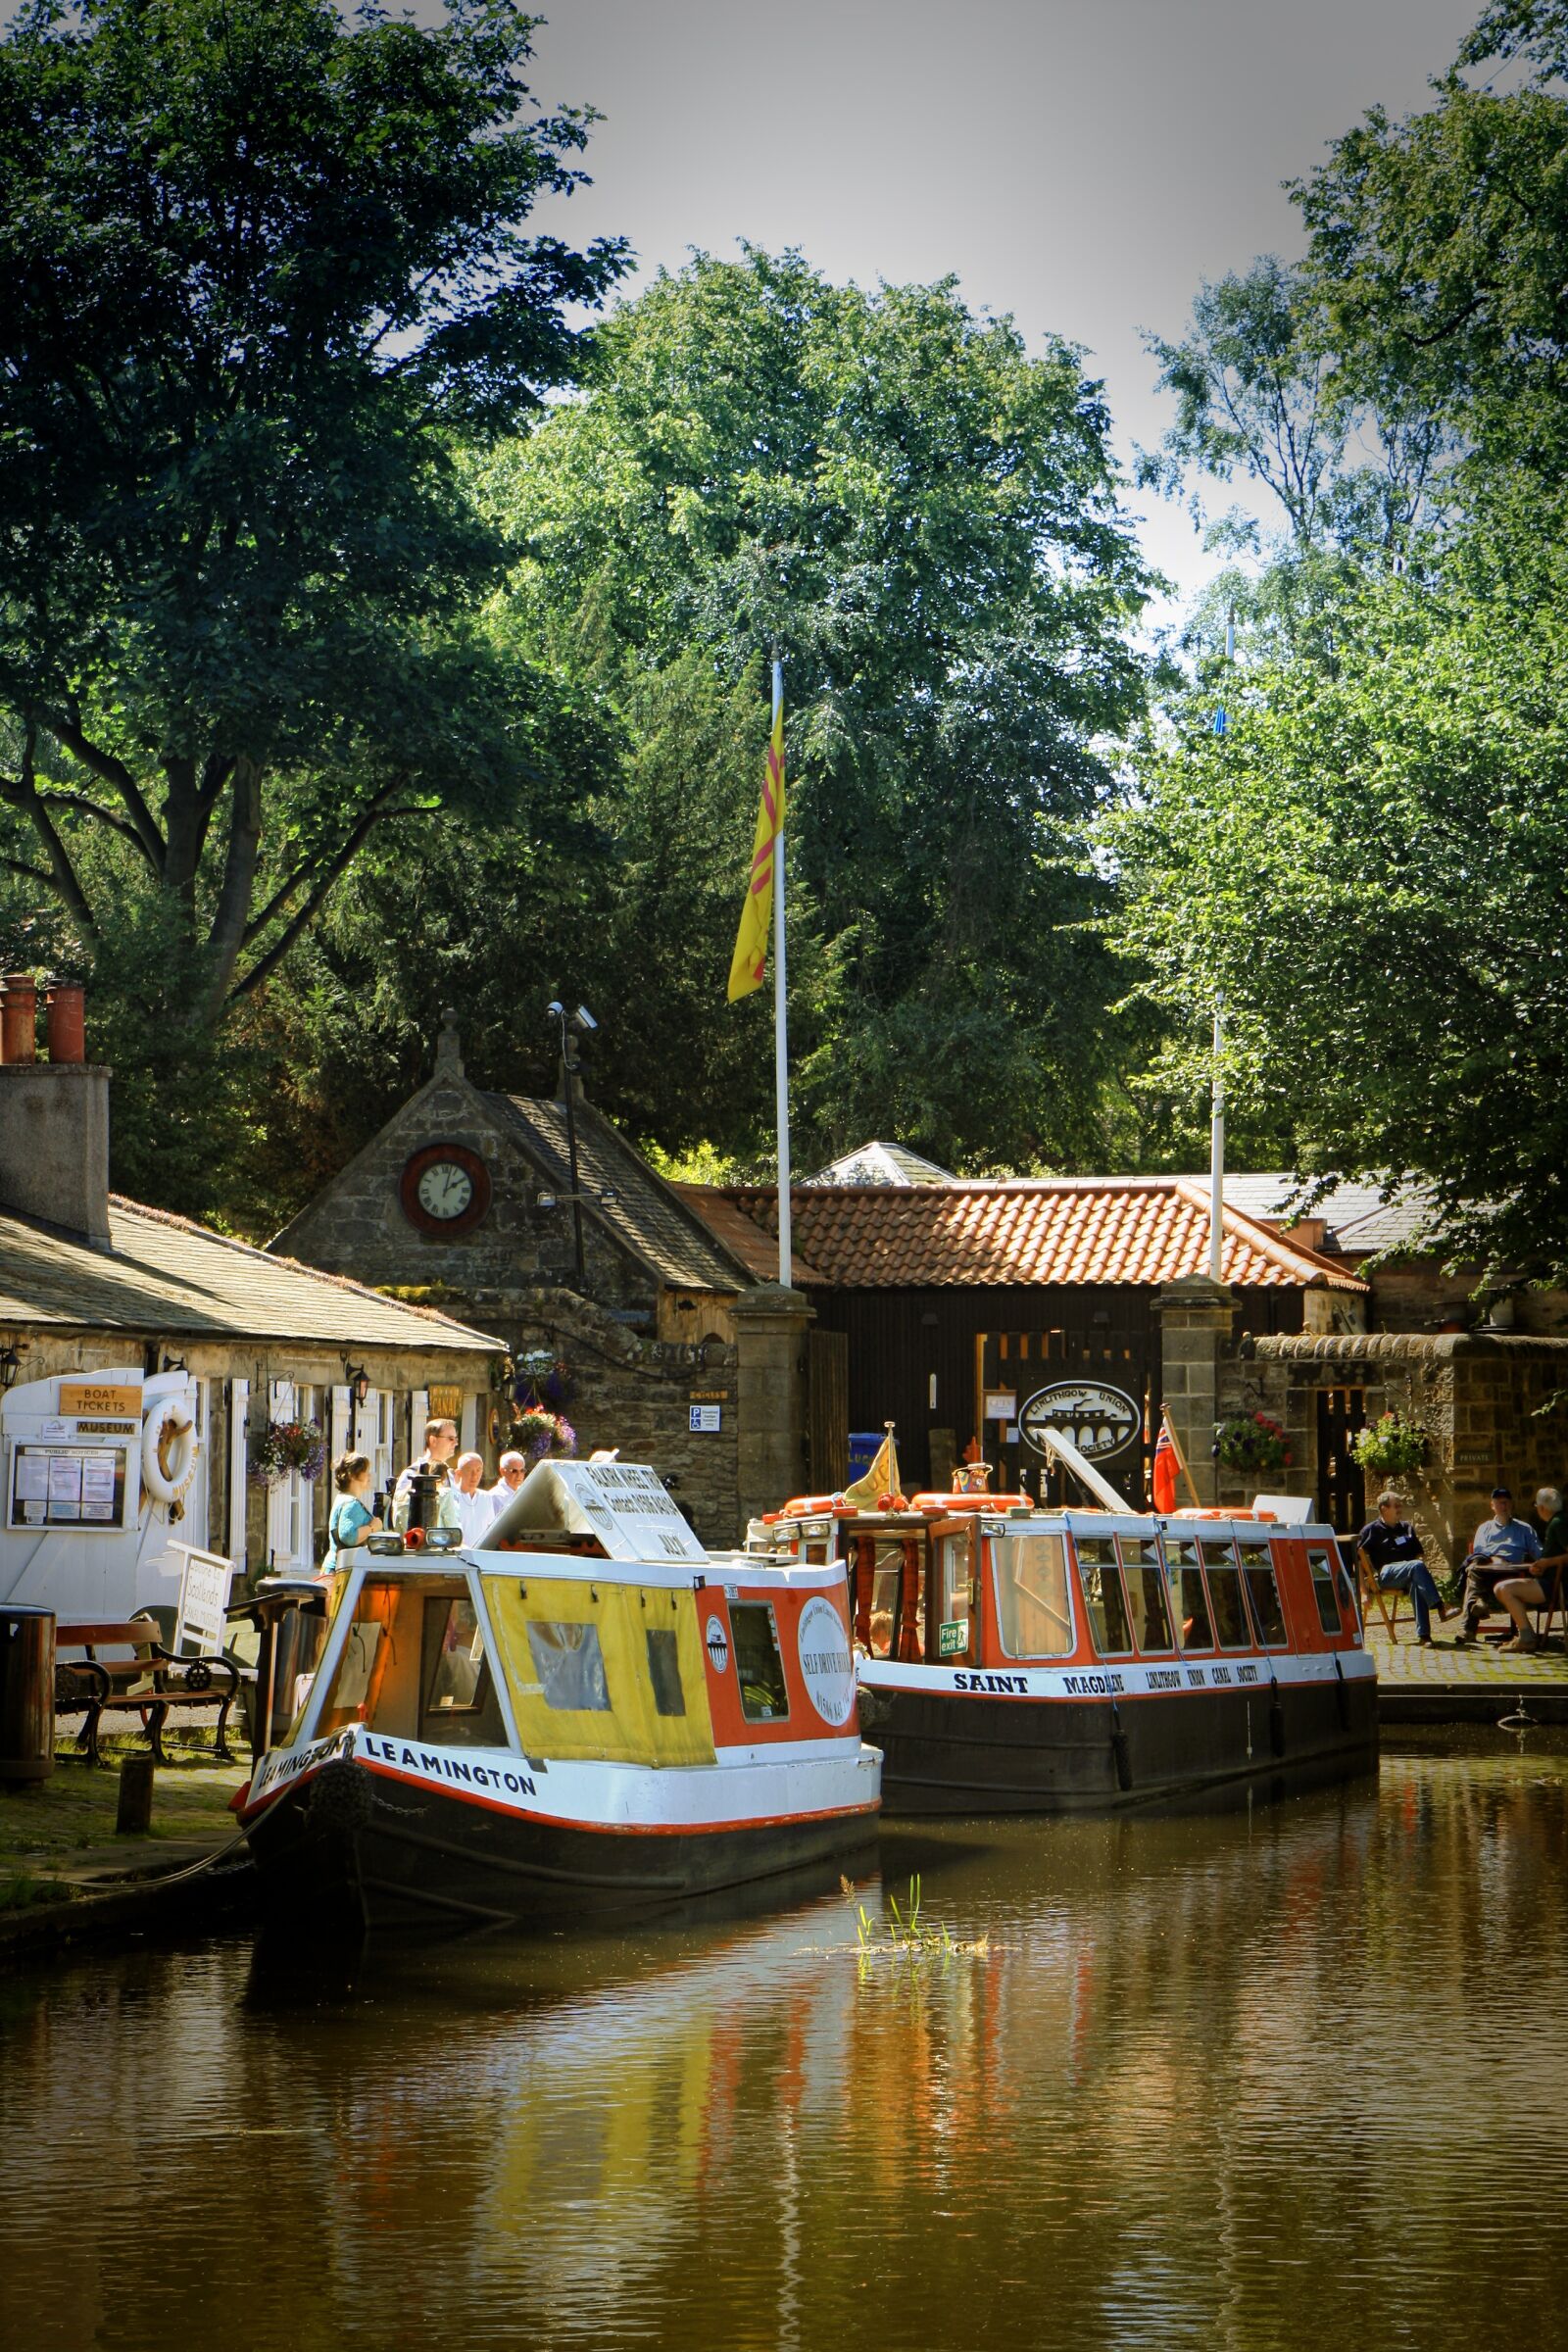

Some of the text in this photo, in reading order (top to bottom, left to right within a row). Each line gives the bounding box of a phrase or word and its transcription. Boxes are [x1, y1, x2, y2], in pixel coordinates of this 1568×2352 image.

[84, 1389, 117, 1398] BOAT
[76, 1399, 125, 1412] TICKETS
[1030, 1390, 1087, 1415] LINLITHGOW
[1099, 1392, 1128, 1413] UNION
[77, 1423, 134, 1433] MUSEUM
[941, 1627, 957, 1641] Fire
[941, 1640, 956, 1651] exit
[803, 1653, 818, 1675] SELF
[818, 1652, 838, 1674] DRIVE
[954, 1673, 1028, 1693] SAINT
[1145, 1670, 1182, 1690] LINLITHGOW
[1187, 1669, 1205, 1687] UNION
[1211, 1667, 1232, 1685] CANAL
[1237, 1665, 1258, 1684] SOCIETY
[366, 1737, 537, 1796] LEAMINGTON
